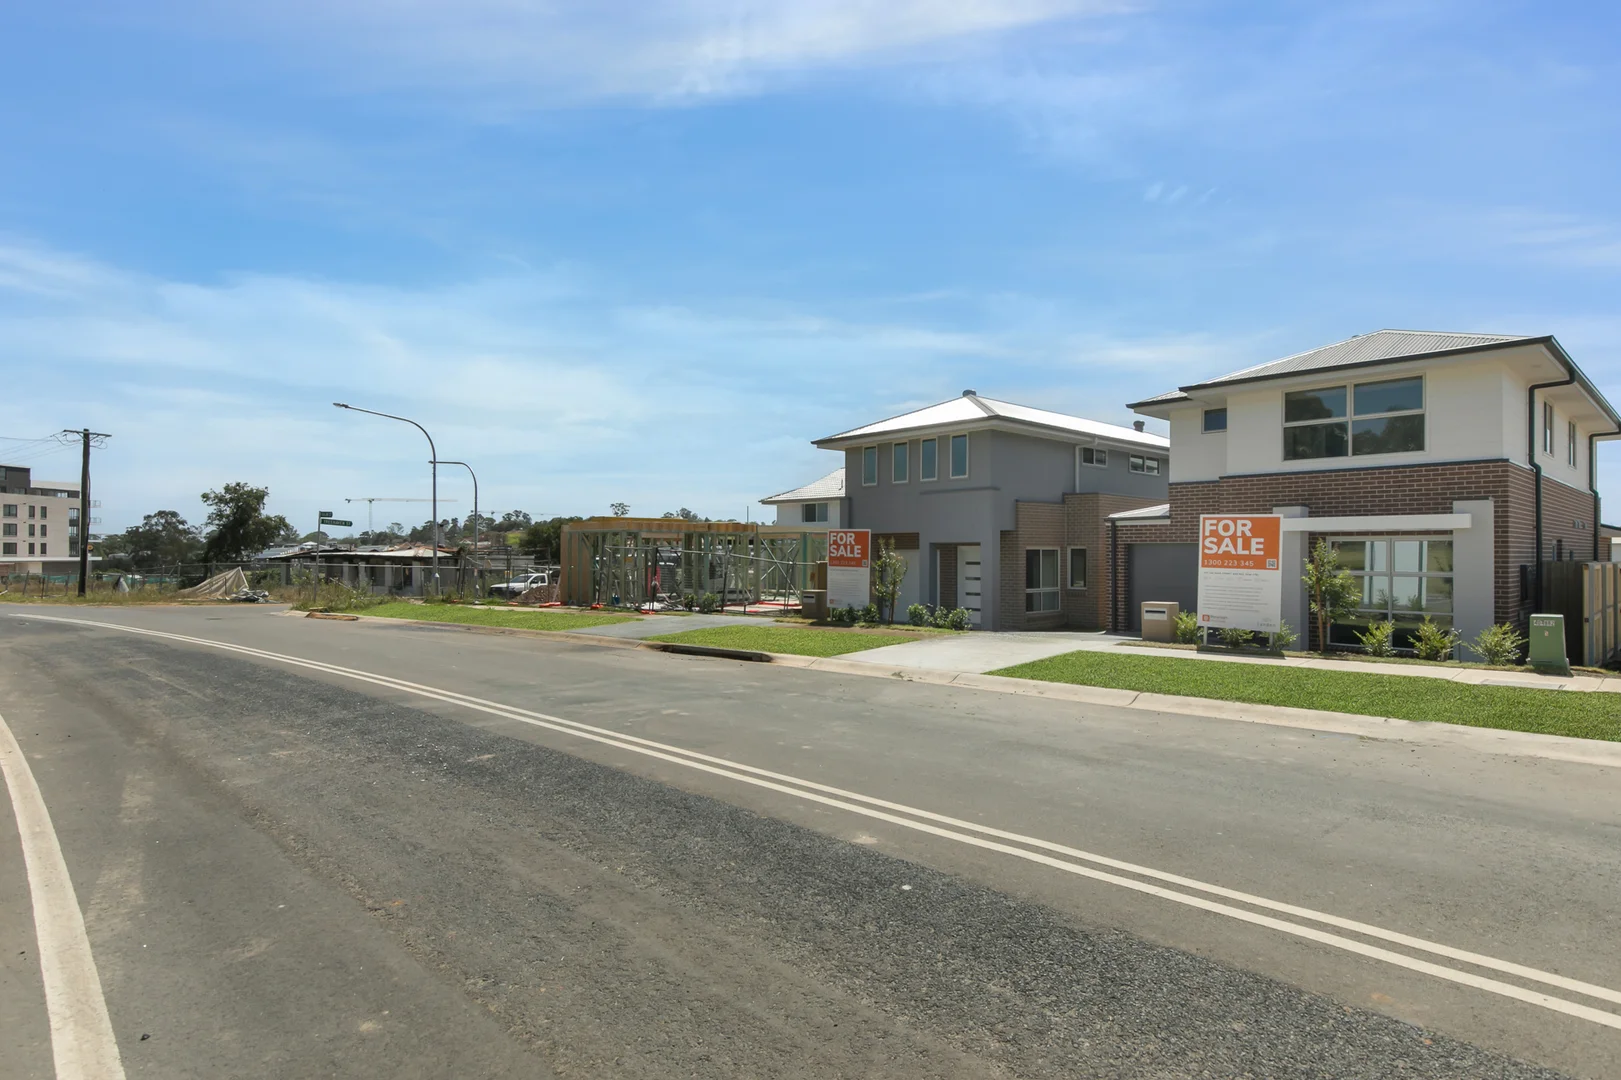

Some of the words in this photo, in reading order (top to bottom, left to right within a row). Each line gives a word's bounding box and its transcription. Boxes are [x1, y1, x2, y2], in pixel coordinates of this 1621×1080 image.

[1204, 519, 1253, 537] FOR
[830, 532, 855, 545] FOR
[829, 545, 862, 557] SALE
[1203, 537, 1265, 555] SALE
[1203, 559, 1222, 567] 1300
